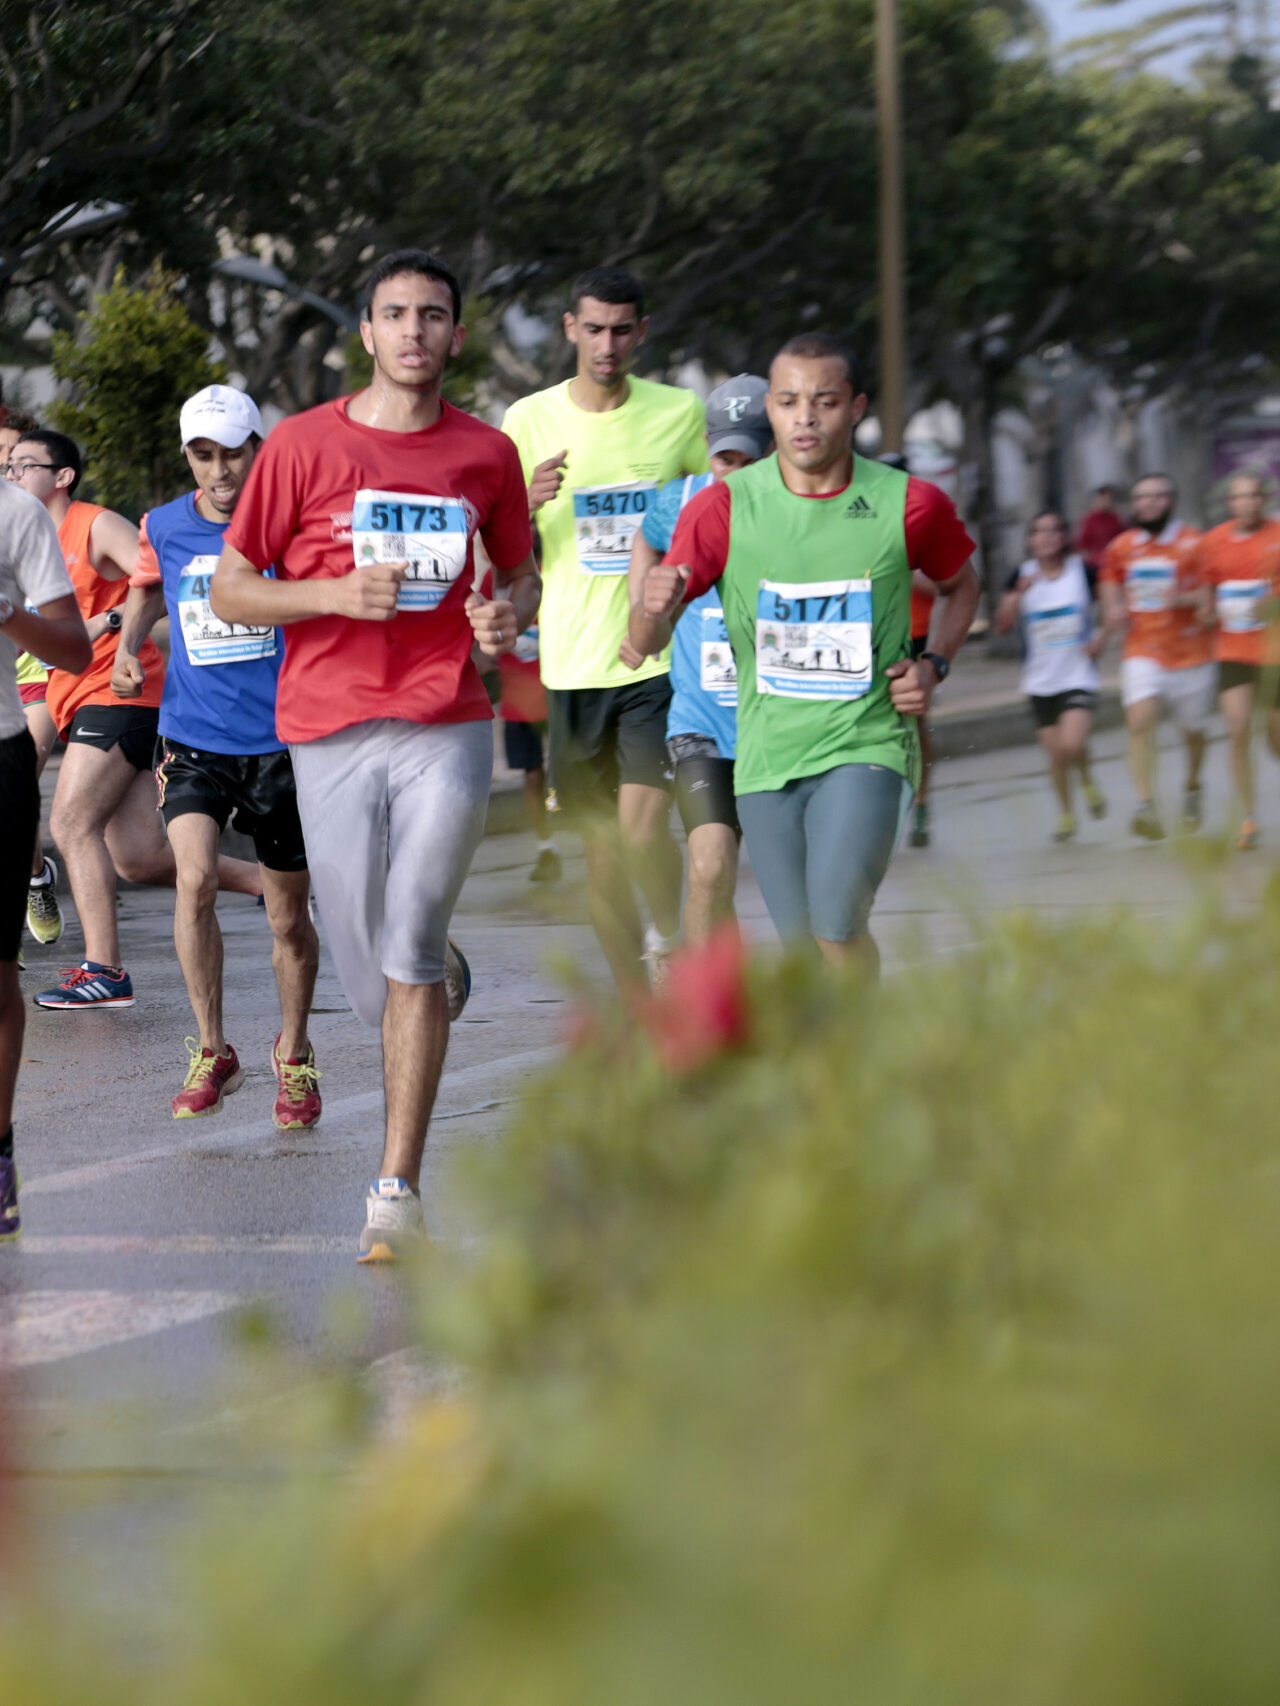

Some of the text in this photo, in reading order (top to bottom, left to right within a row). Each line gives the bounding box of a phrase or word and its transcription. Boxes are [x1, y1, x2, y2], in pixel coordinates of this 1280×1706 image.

[586, 491, 646, 515] 5470
[371, 504, 447, 531] 5173
[191, 575, 211, 599] 4
[774, 592, 848, 621] 5171
